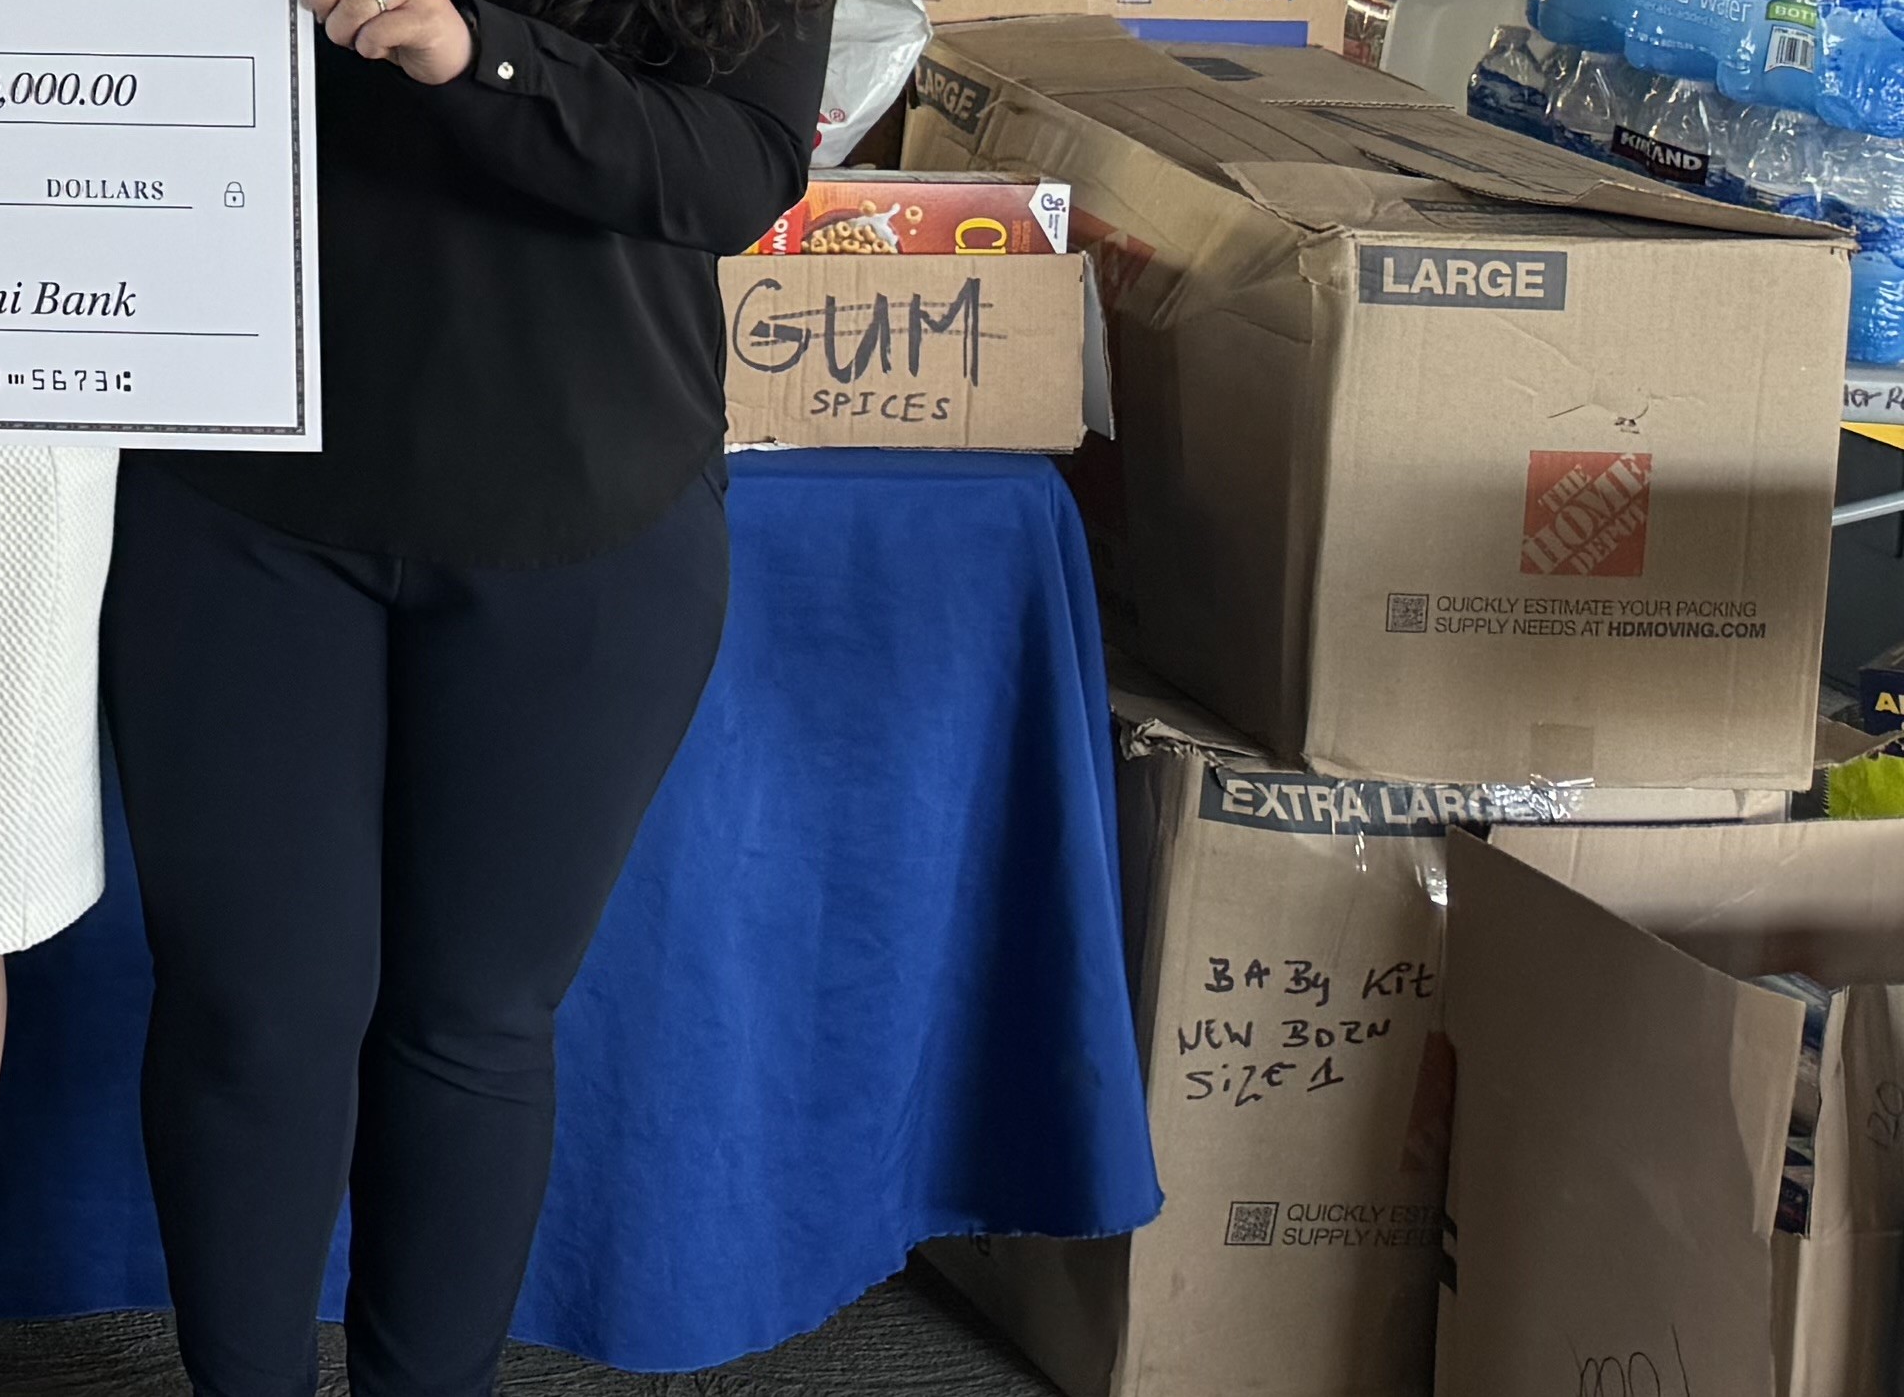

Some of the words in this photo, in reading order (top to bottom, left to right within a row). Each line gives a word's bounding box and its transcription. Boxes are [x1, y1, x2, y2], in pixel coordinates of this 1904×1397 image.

[915, 63, 977, 121] LARGE
[46, 178, 166, 201] DOLLARS
[1383, 257, 1546, 298] LARGE
[30, 279, 137, 317] Bank
[732, 278, 981, 387] GUM
[810, 389, 951, 422] SPICES
[1537, 463, 1591, 513] THE
[1521, 453, 1649, 574] HOME
[1568, 500, 1648, 575] DEPOT
[1436, 596, 1519, 615] QUICKLY
[1524, 598, 1613, 616] ESTIMATE
[1617, 600, 1670, 617] YOUR
[1675, 600, 1757, 619] PACKING
[1434, 617, 1509, 634] SUPPLY
[1513, 619, 1576, 636] NEEDS
[1581, 620, 1605, 636] AT
[1607, 621, 1766, 639] HDMOVING.COM
[1222, 779, 1371, 824] EXTRA
[1361, 961, 1435, 1000] Kit
[1177, 1018, 1253, 1055] NEW
[1306, 1056, 1344, 1092] 1
[1287, 1203, 1386, 1223] QUICKLY
[1282, 1227, 1370, 1247] SUPPLY
